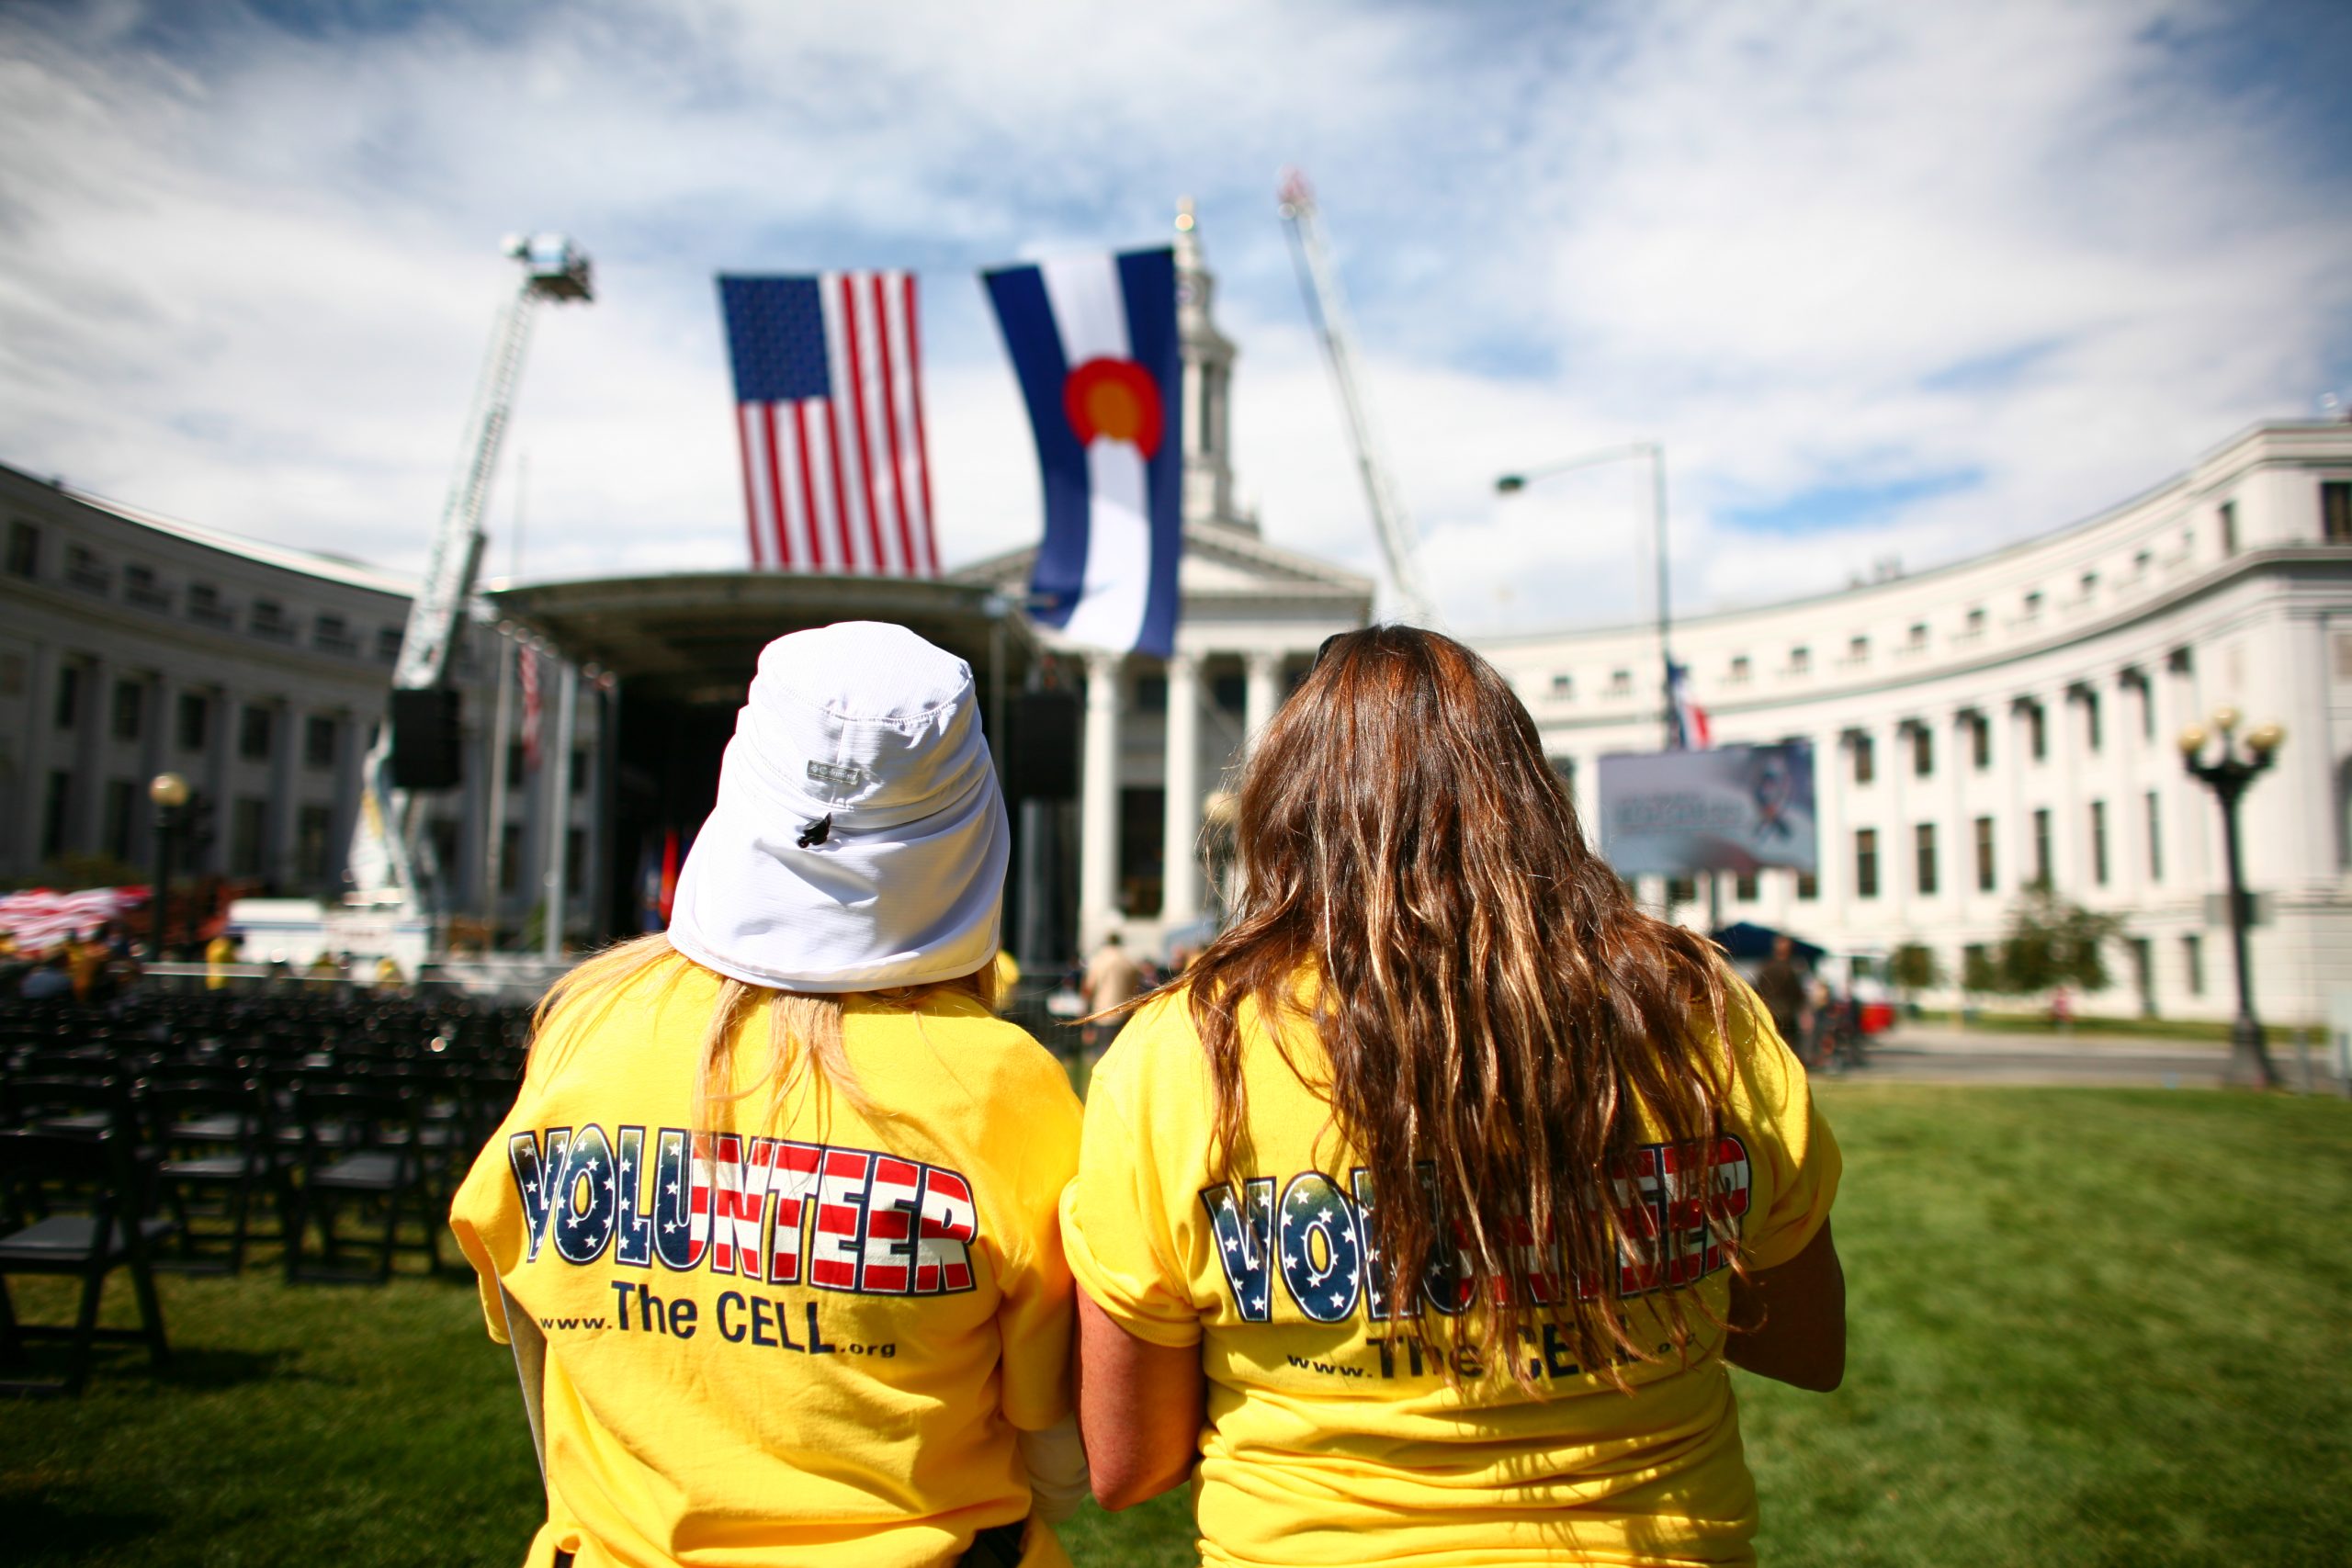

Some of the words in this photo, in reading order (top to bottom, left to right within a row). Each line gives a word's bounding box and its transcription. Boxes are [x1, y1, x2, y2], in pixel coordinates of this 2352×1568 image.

[509, 1122, 978, 1297] VOLUNTEER
[1197, 1133, 1753, 1324] VOLUEER
[717, 1291, 898, 1359] CELL.org
